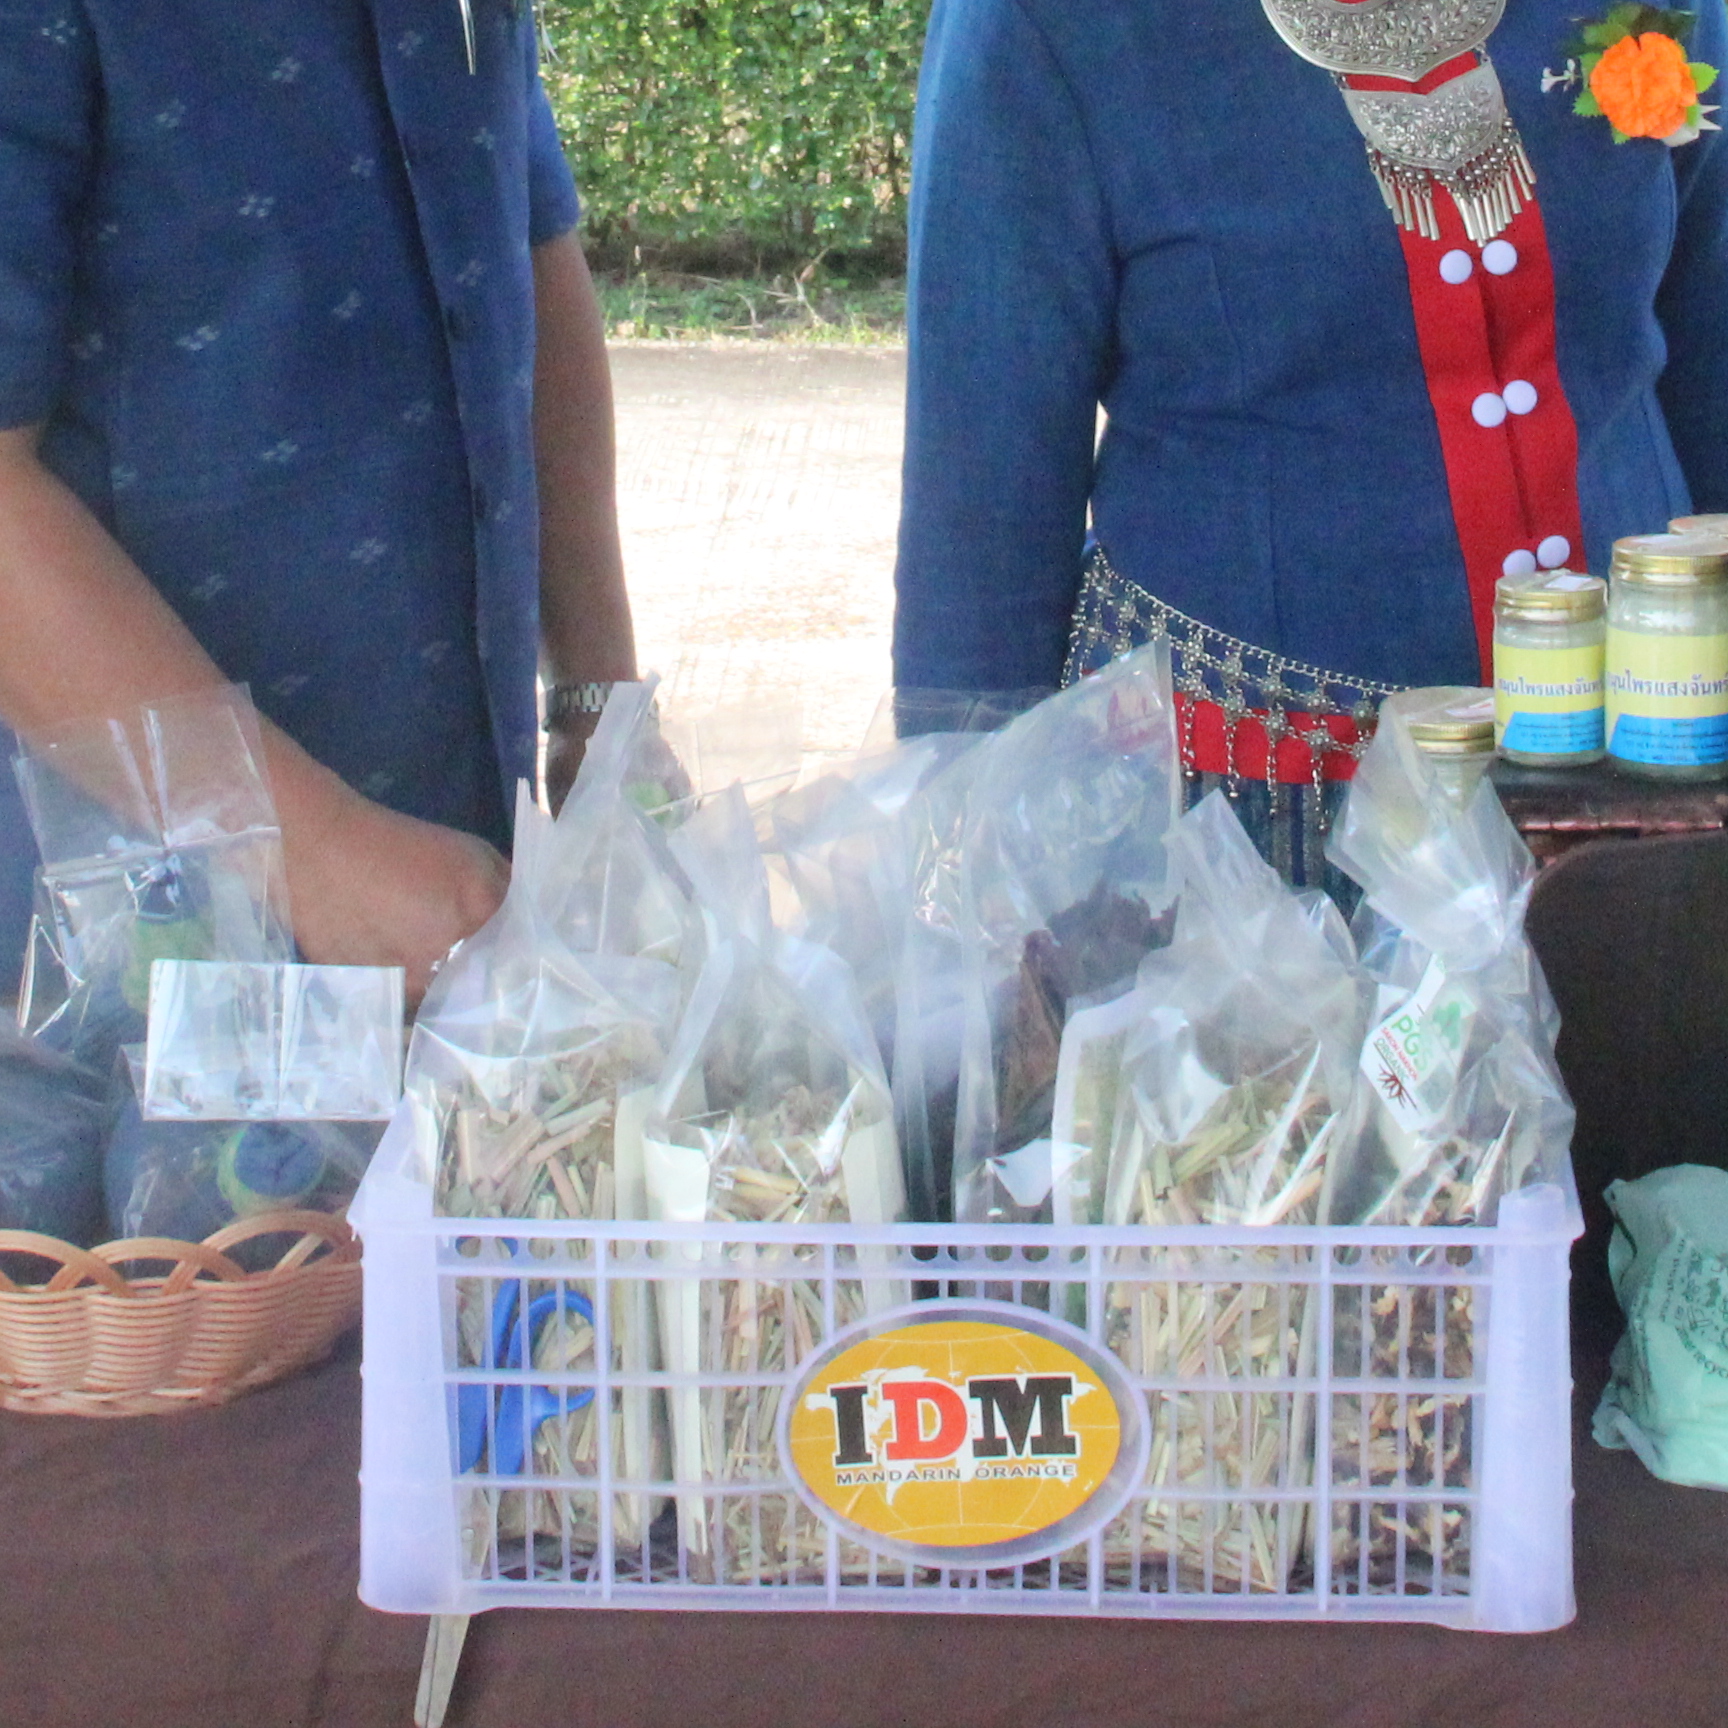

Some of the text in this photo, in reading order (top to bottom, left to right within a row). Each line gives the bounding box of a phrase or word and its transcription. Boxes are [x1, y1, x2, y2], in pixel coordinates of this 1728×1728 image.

[829, 1375, 1078, 1467] IDM
[836, 1463, 1077, 1485] MANDARIN ORANGE
